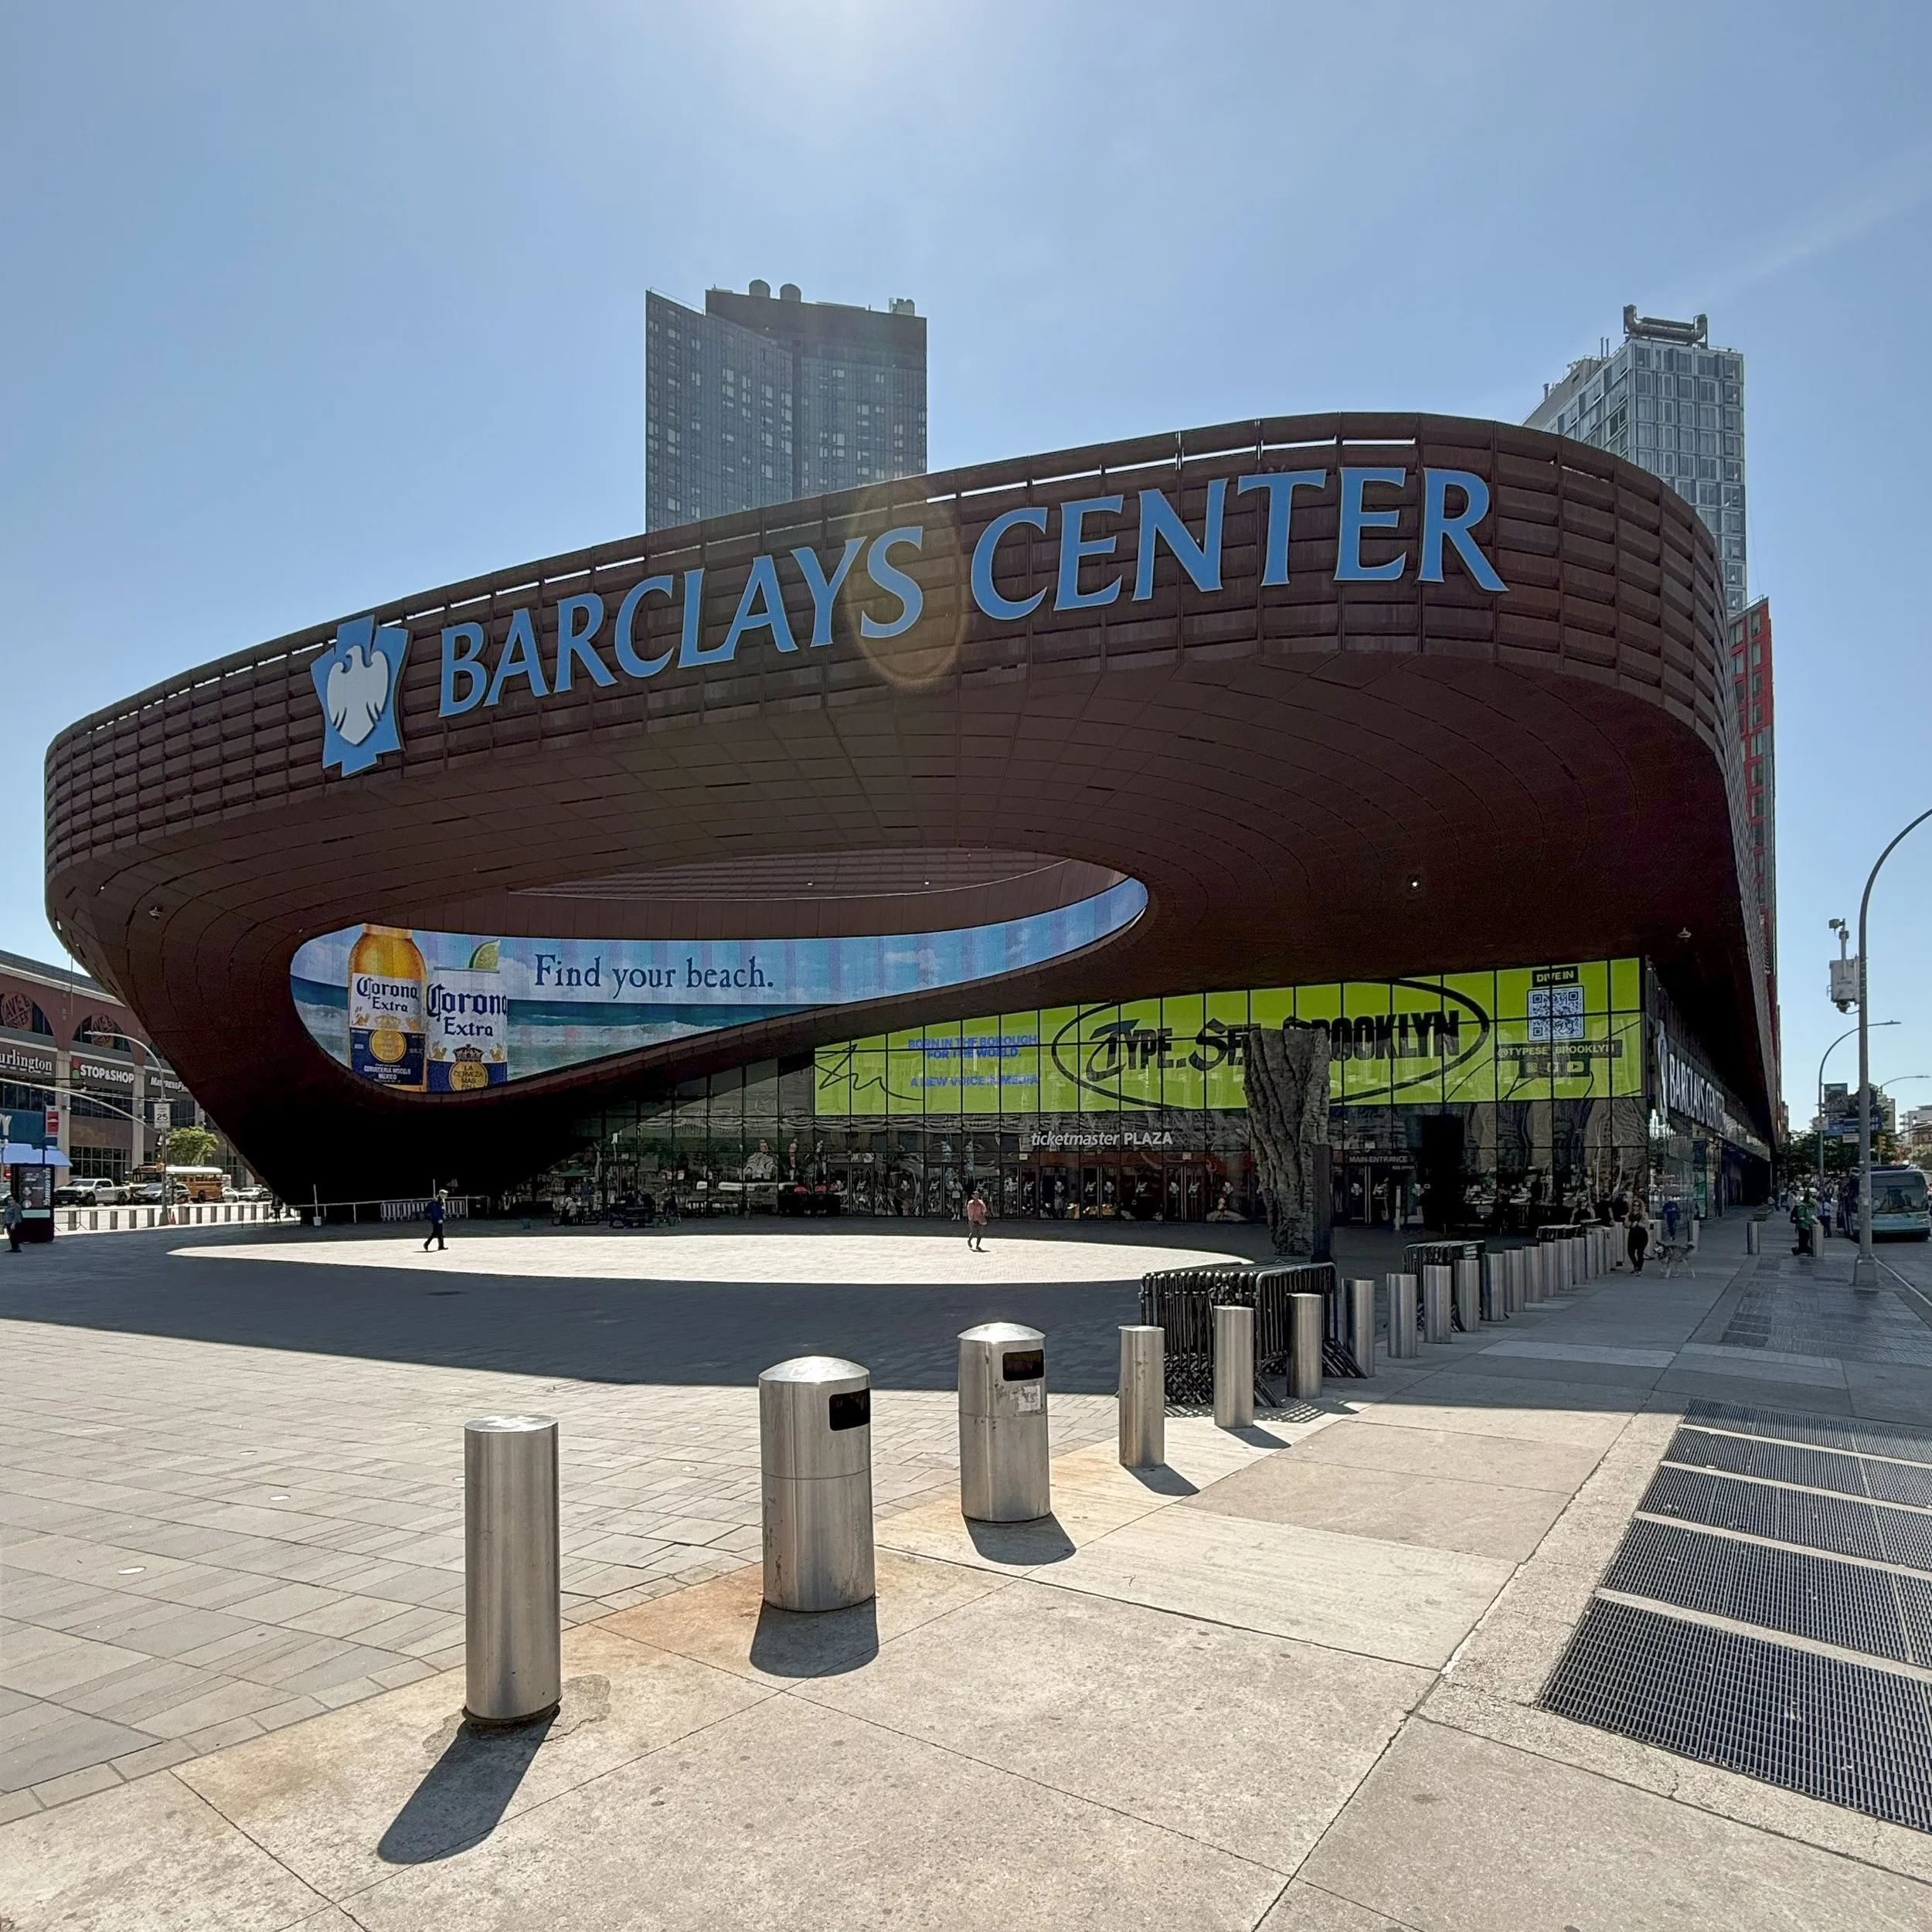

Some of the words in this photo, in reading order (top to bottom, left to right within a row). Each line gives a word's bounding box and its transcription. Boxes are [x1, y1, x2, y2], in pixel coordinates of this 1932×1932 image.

[438, 526, 923, 717] BARCLAYS
[970, 466, 1506, 620] CENTER
[535, 954, 601, 986] Find
[612, 968, 675, 999] your
[686, 956, 774, 988] beach.
[1536, 971, 1561, 982] DIVE
[1563, 971, 1574, 979] IN
[356, 977, 420, 1000] Corona
[372, 996, 408, 1012] Extra
[444, 1016, 494, 1036] Extra
[941, 1037, 953, 1047] IN
[1087, 1019, 1261, 1082] TYPE.SE
[1284, 1009, 1460, 1062] OOKLYN
[1498, 1043, 1615, 1057] @TYPESEBROOKLYN
[0, 1049, 53, 1073] urlington
[927, 1048, 949, 1059] FOR
[910, 1077, 918, 1087] A
[1031, 1131, 1120, 1145] ticketmaster
[1124, 1131, 1173, 1145] PLAZA
